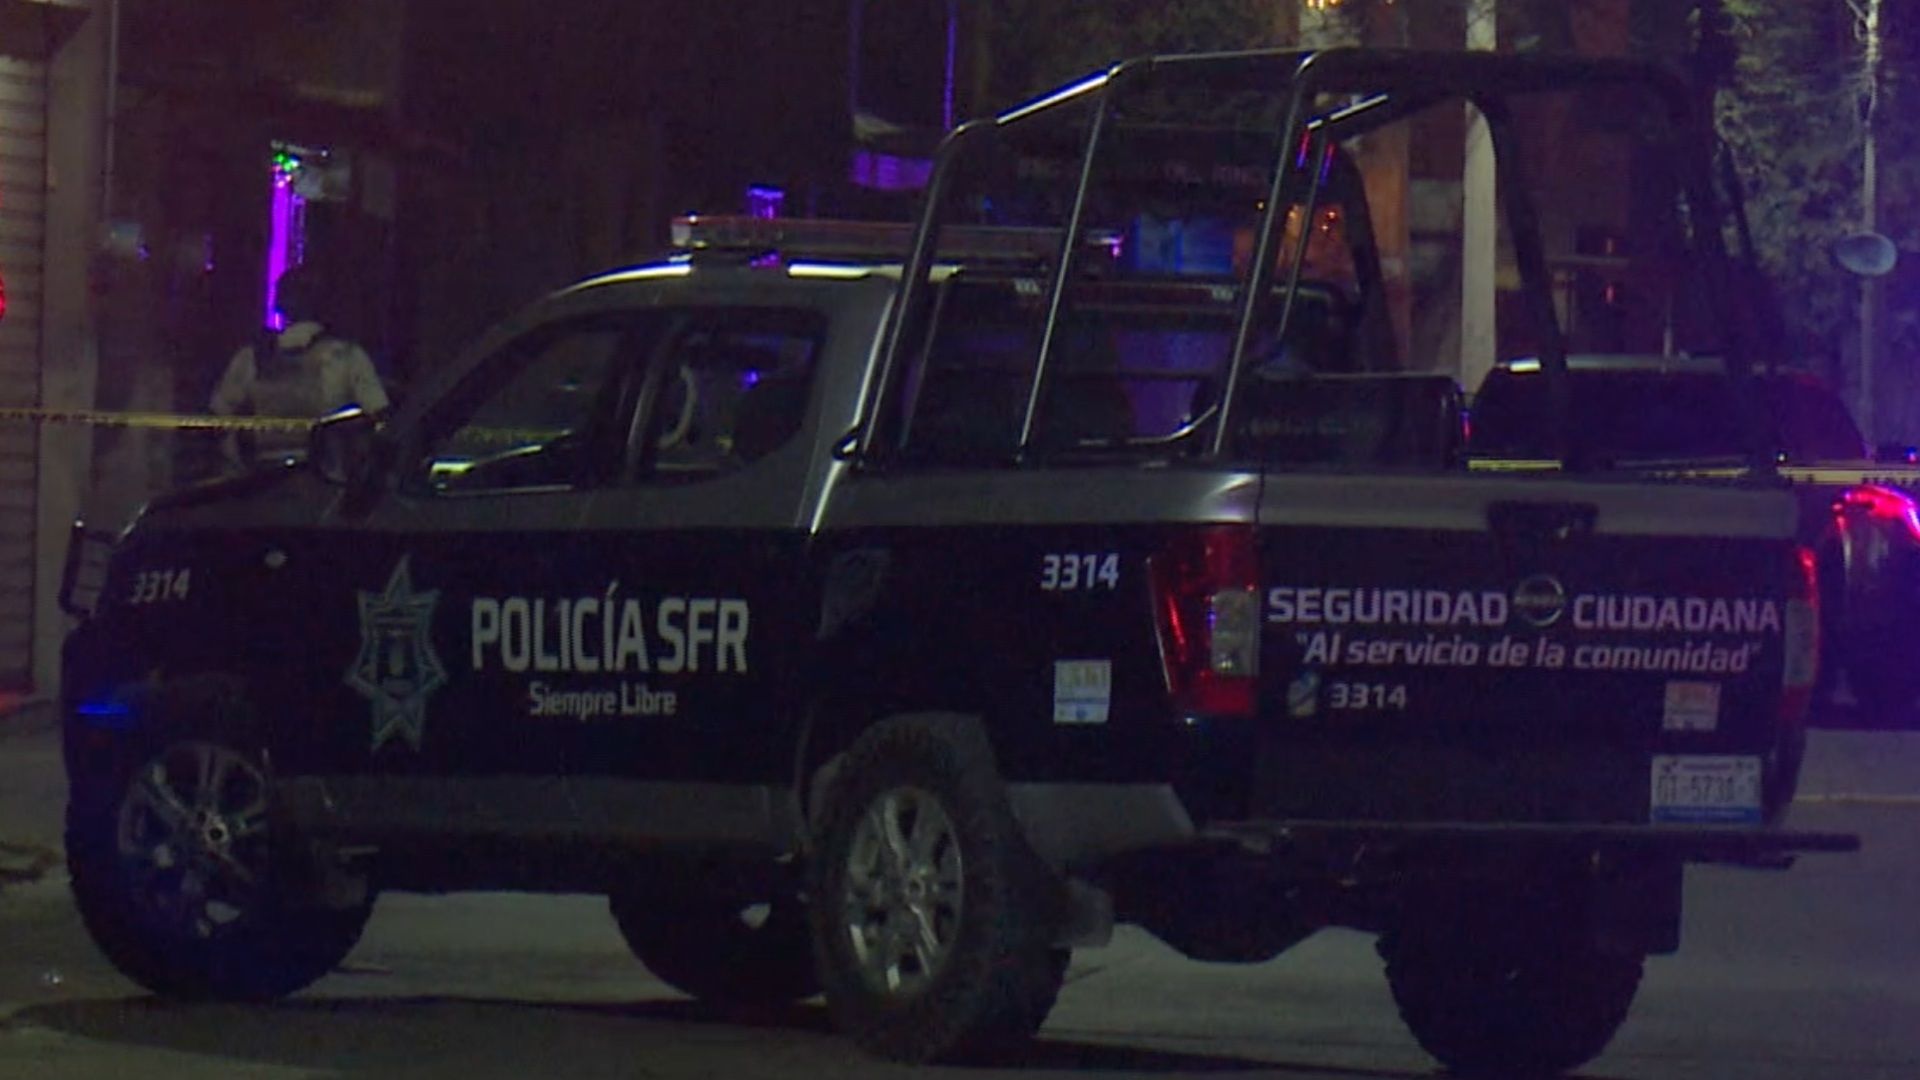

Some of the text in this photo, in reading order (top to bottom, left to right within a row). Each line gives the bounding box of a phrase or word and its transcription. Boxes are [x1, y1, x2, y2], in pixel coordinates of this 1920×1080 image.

[129, 567, 191, 605] 3314
[1041, 553, 1120, 592] 3314
[471, 578, 750, 674] POLICÍA SFR
[1267, 586, 1780, 632] SEGURIDAD CIUDADANA
[1345, 632, 1481, 667] servicio
[1486, 634, 1530, 668] de
[1533, 636, 1566, 669] la
[528, 681, 678, 722] Siempre Libre
[1328, 682, 1408, 711] 3314
